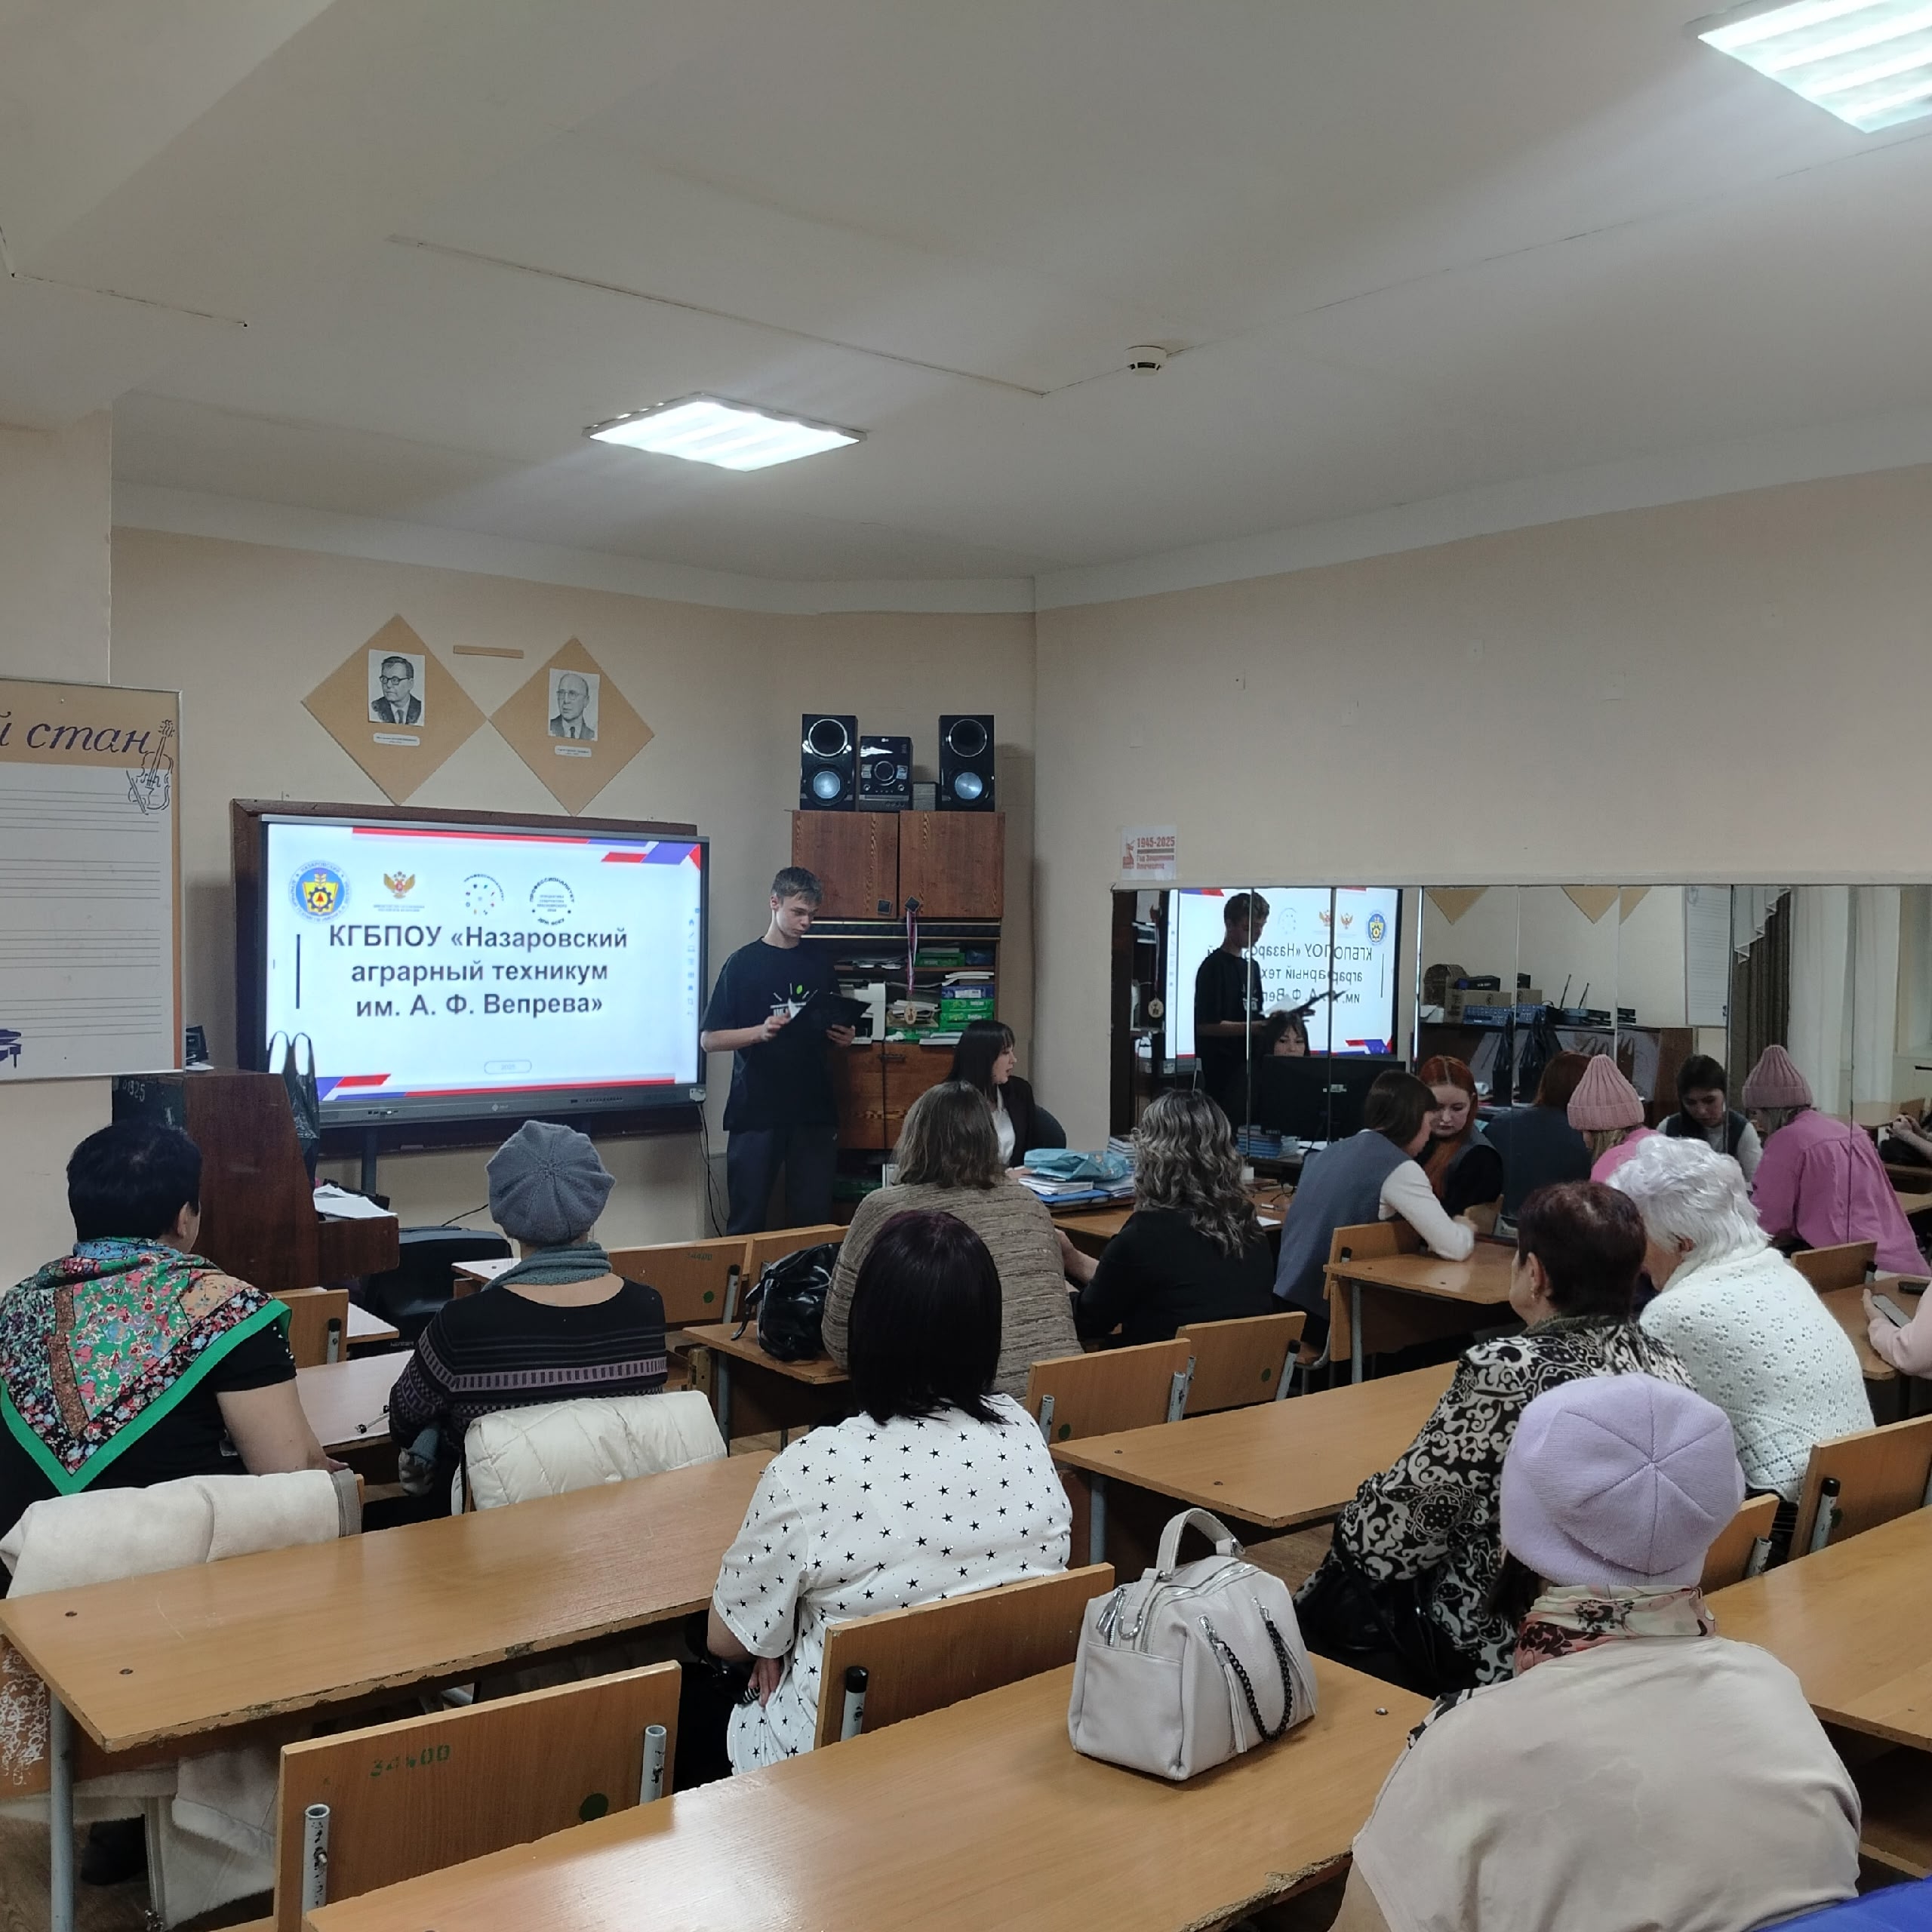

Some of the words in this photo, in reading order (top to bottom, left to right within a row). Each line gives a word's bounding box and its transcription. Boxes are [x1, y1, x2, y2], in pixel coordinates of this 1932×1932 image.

[27, 724, 150, 753] стан
[1137, 835, 1175, 848] 1945-2025
[330, 924, 442, 947] КГБПОУ
[451, 926, 627, 953] «Назаровский
[351, 960, 484, 987] аграрный
[491, 964, 608, 986] техникум
[356, 1001, 400, 1017] им.
[409, 994, 436, 1016] А.
[445, 994, 474, 1015] Ф.
[484, 993, 602, 1019] Вепрева»
